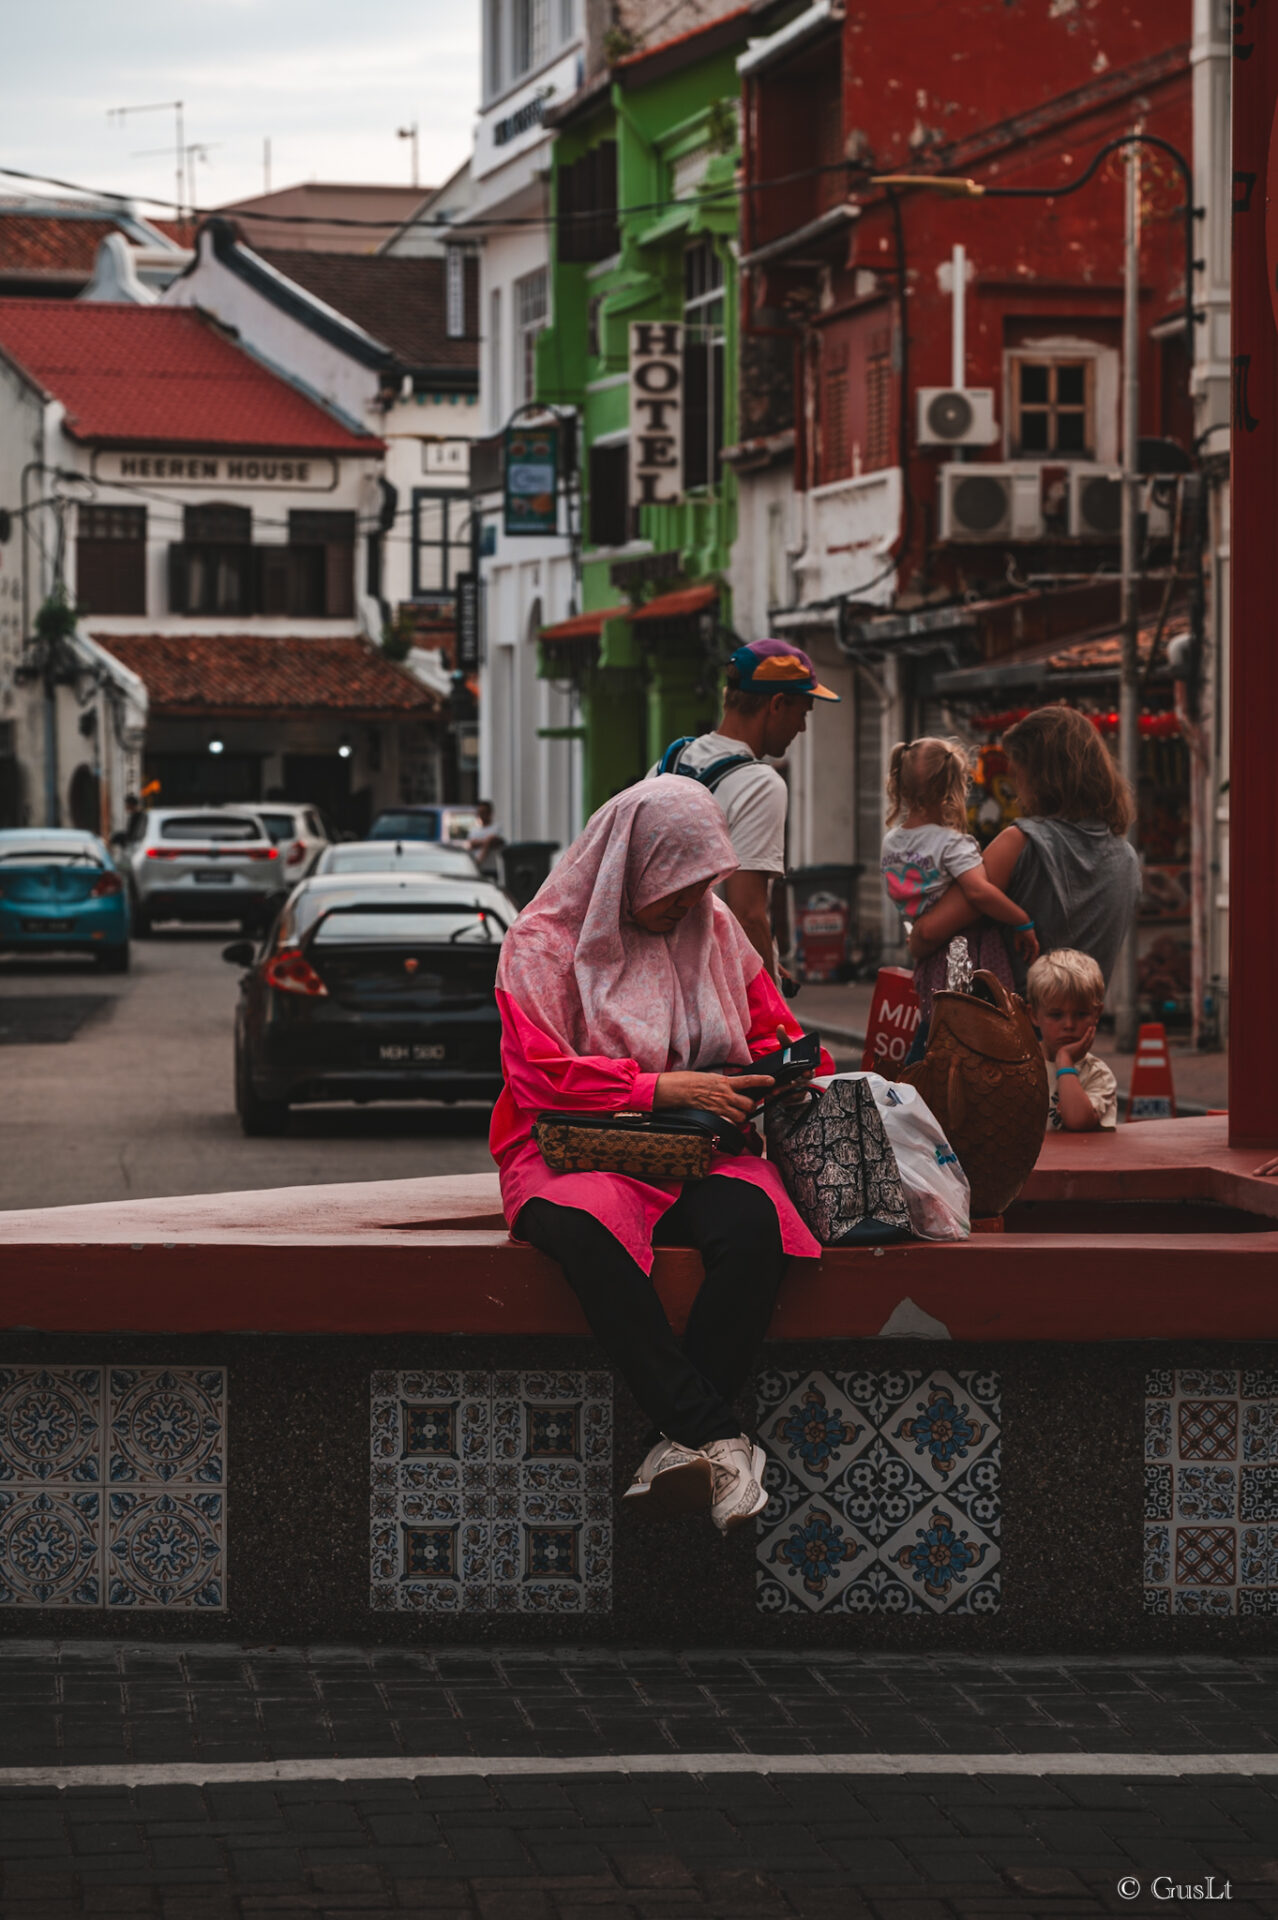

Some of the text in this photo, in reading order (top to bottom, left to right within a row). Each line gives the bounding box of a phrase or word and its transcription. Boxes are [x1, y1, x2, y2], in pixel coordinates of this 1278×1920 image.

[634, 323, 680, 504] HOTEL
[120, 457, 310, 482] HEEREN HOUSE
[874, 1031, 914, 1061] SO
